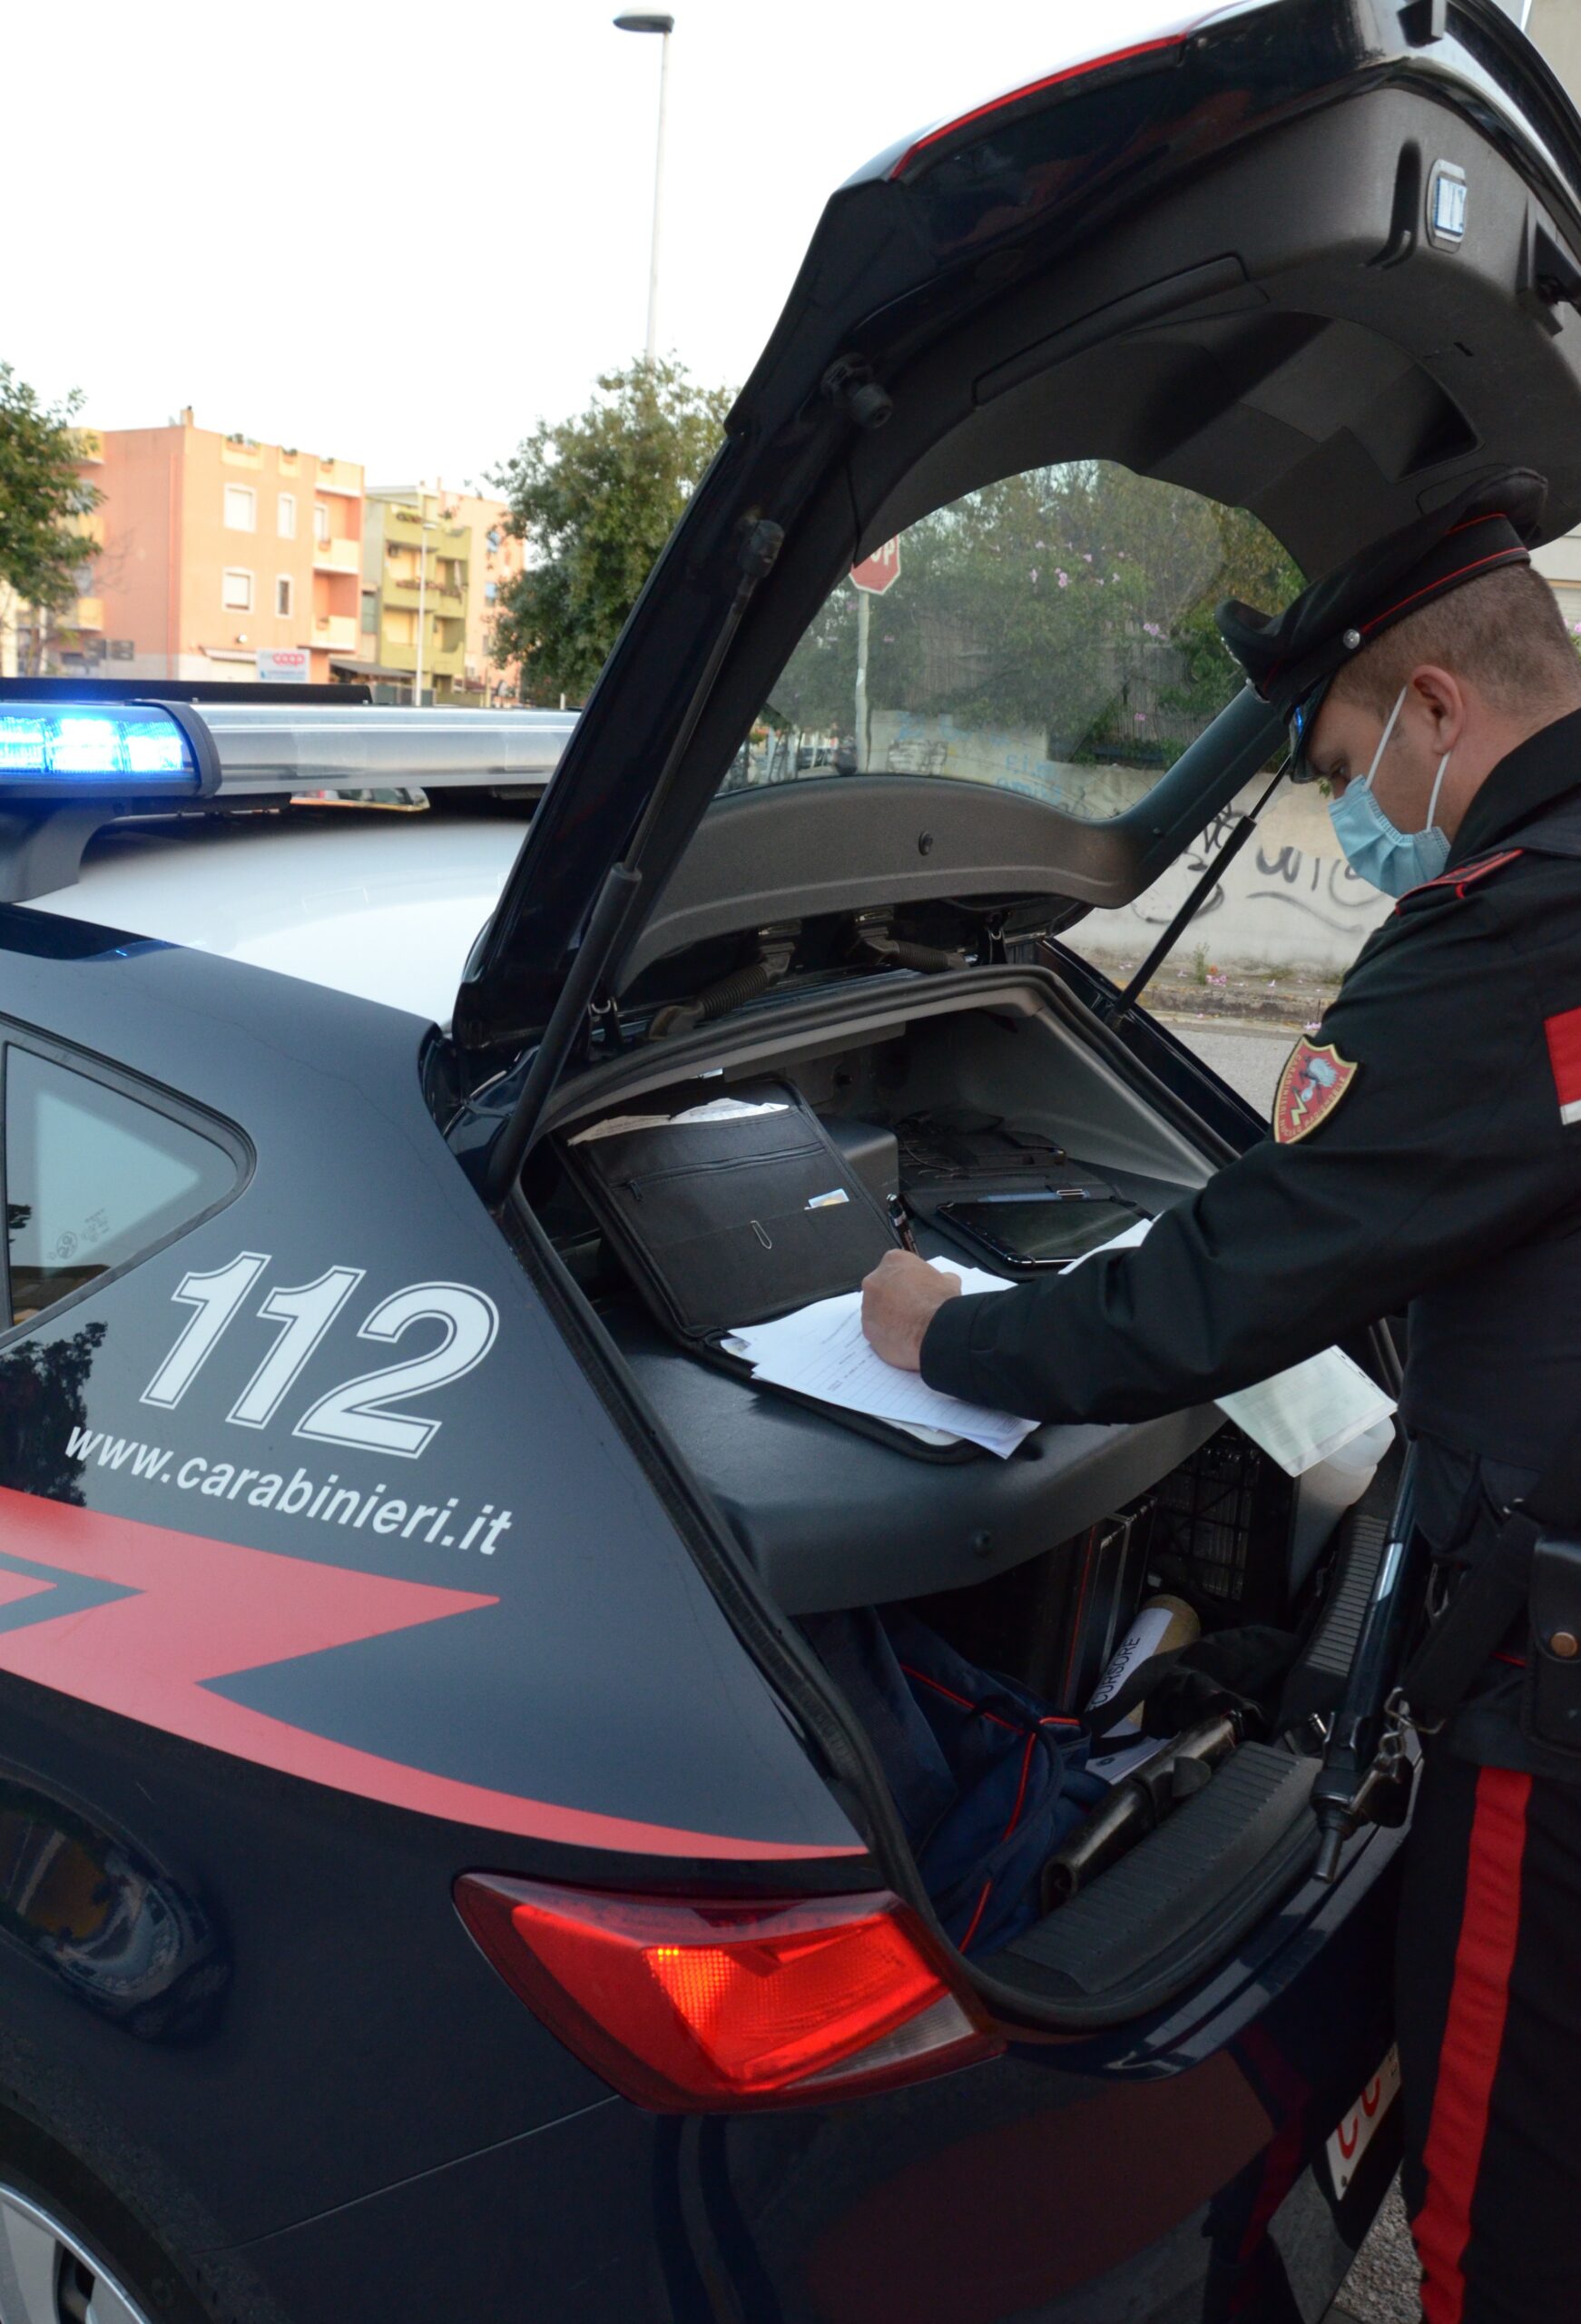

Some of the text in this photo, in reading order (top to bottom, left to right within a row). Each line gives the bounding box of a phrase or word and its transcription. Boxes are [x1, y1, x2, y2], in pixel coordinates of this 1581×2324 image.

[139, 1251, 500, 1459] 112
[65, 1426, 513, 1554] www.carabinieri.it
[1090, 1637, 1141, 1709] CURSORE
